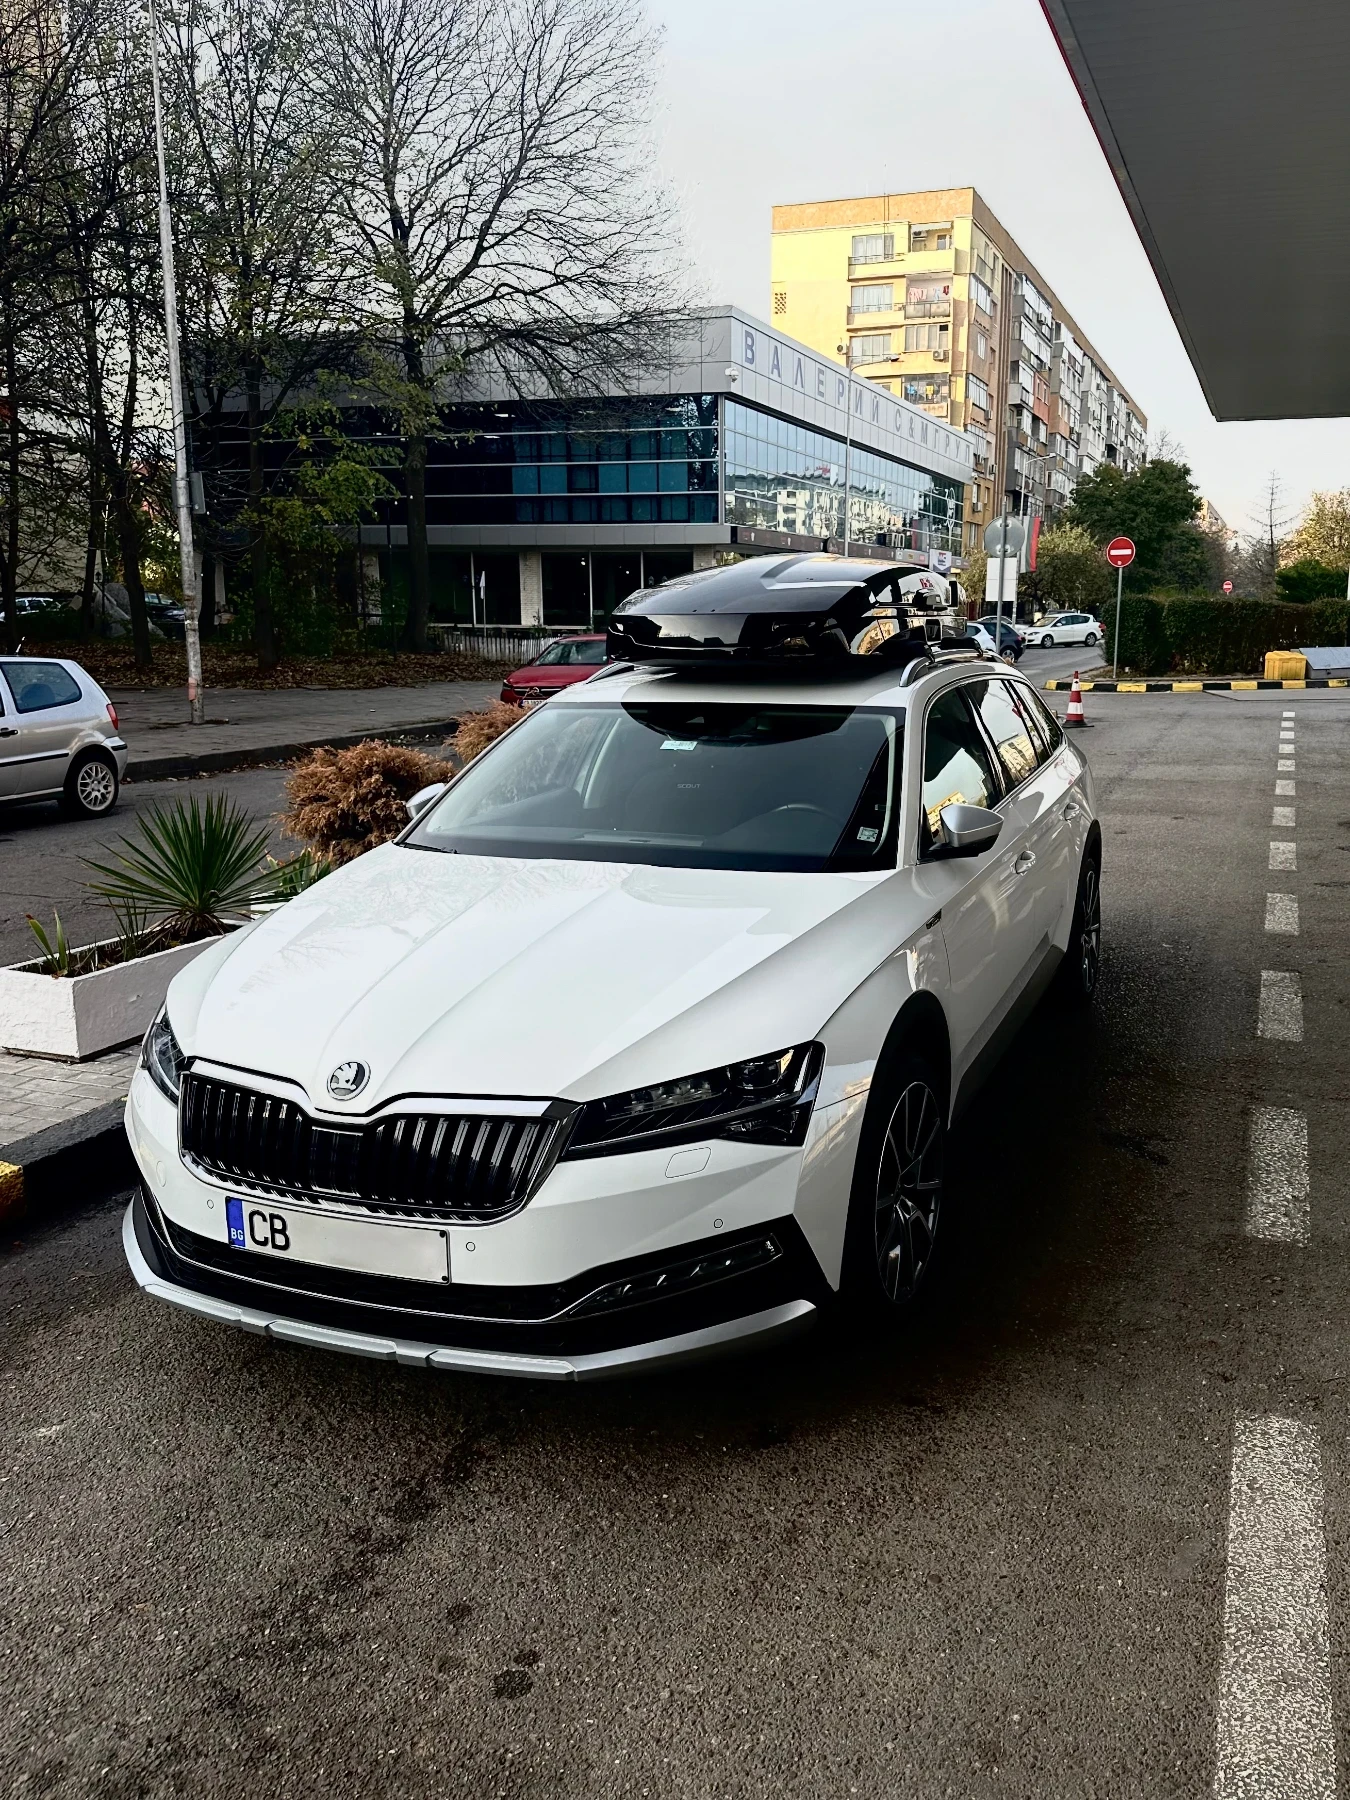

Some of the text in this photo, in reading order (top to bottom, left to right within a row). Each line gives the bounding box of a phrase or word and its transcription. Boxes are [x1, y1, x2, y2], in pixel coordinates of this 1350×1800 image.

[744, 329, 879, 424] ВАЛЕРИЙ
[230, 1209, 290, 1251] BG CB
